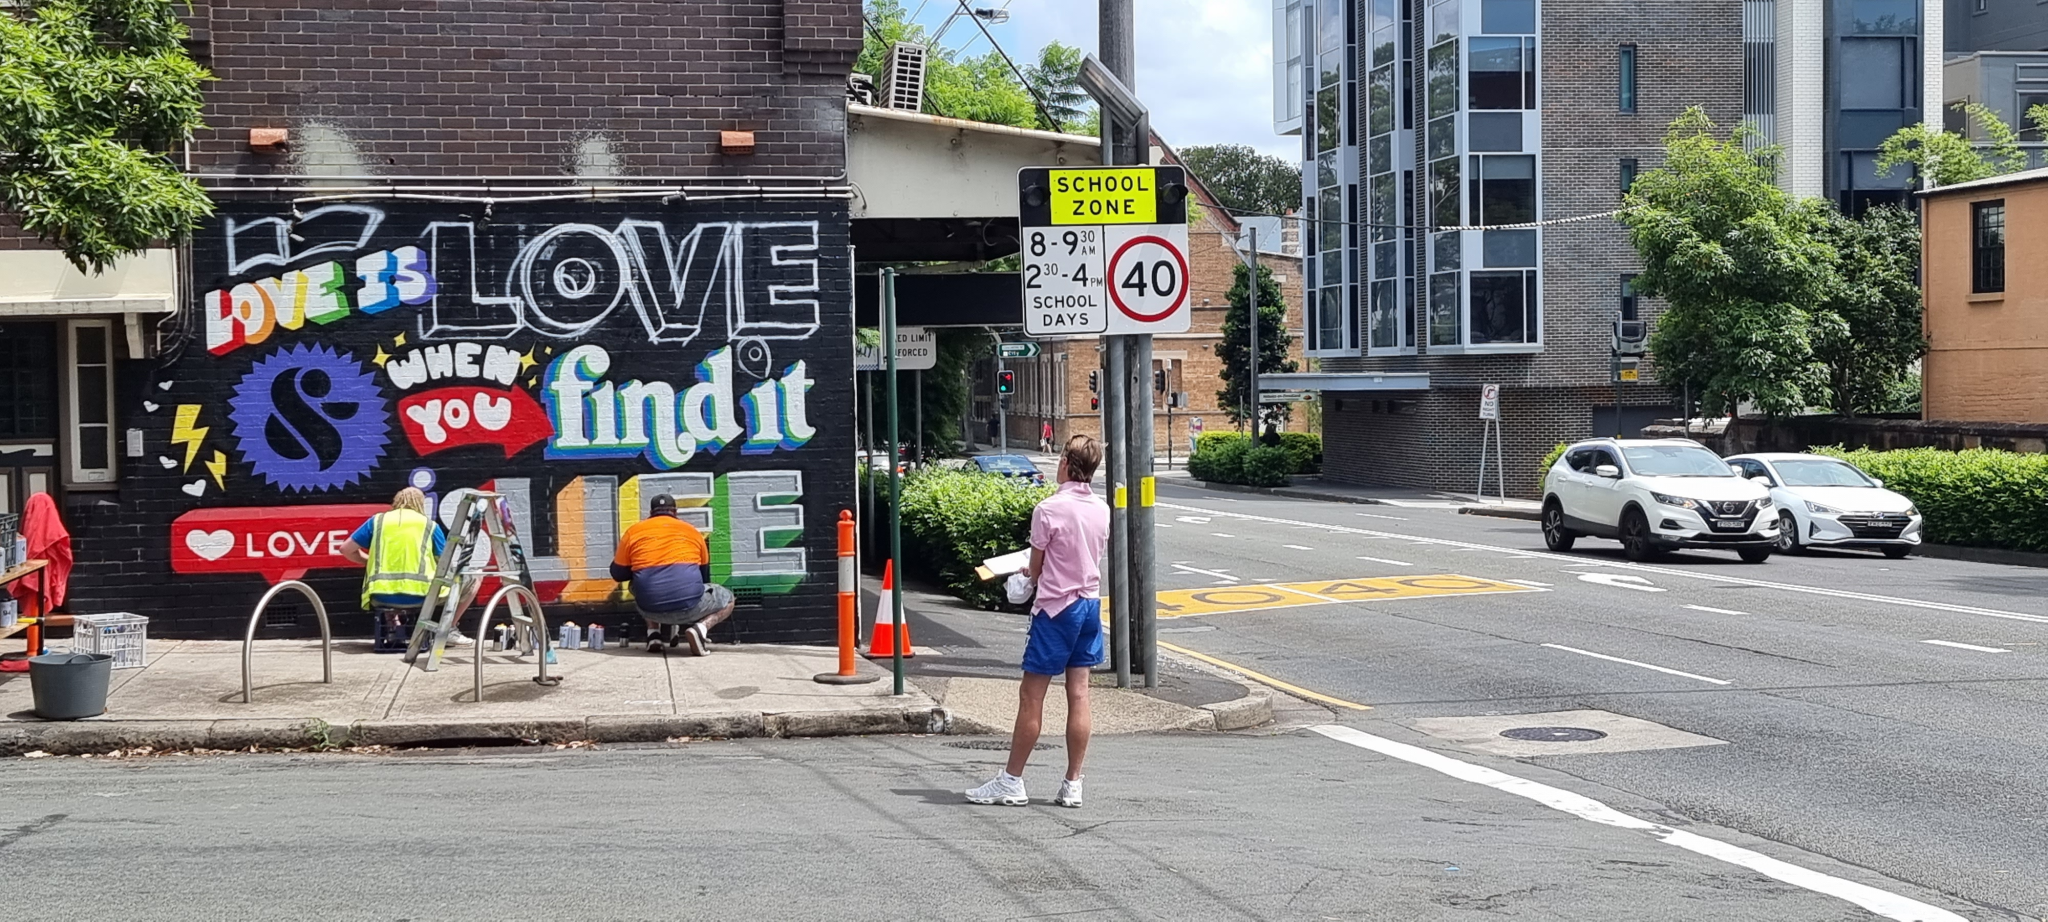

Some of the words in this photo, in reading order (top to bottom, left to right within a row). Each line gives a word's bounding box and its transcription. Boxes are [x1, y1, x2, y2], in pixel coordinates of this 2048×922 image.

[1057, 176, 1149, 193] SCHOOL
[1072, 199, 1135, 215] ZONE
[1081, 245, 1096, 256] AM
[418, 219, 820, 345] LOVE
[1090, 277, 1103, 287] PM
[1121, 260, 1176, 297] 40
[205, 260, 351, 356] LOVE
[357, 245, 438, 315] IS
[1033, 295, 1098, 309] SCHOOL
[1043, 313, 1089, 327] DAYS
[896, 334, 907, 343] ED
[911, 333, 932, 343] LIMIT
[896, 348, 928, 357] FORCED
[386, 342, 521, 391] WHEN
[541, 344, 745, 470] find
[740, 359, 816, 455] it
[406, 391, 511, 444] YOU
[246, 529, 349, 559] LOVE
[477, 470, 807, 606] LIFE
[1322, 578, 1496, 597] 40
